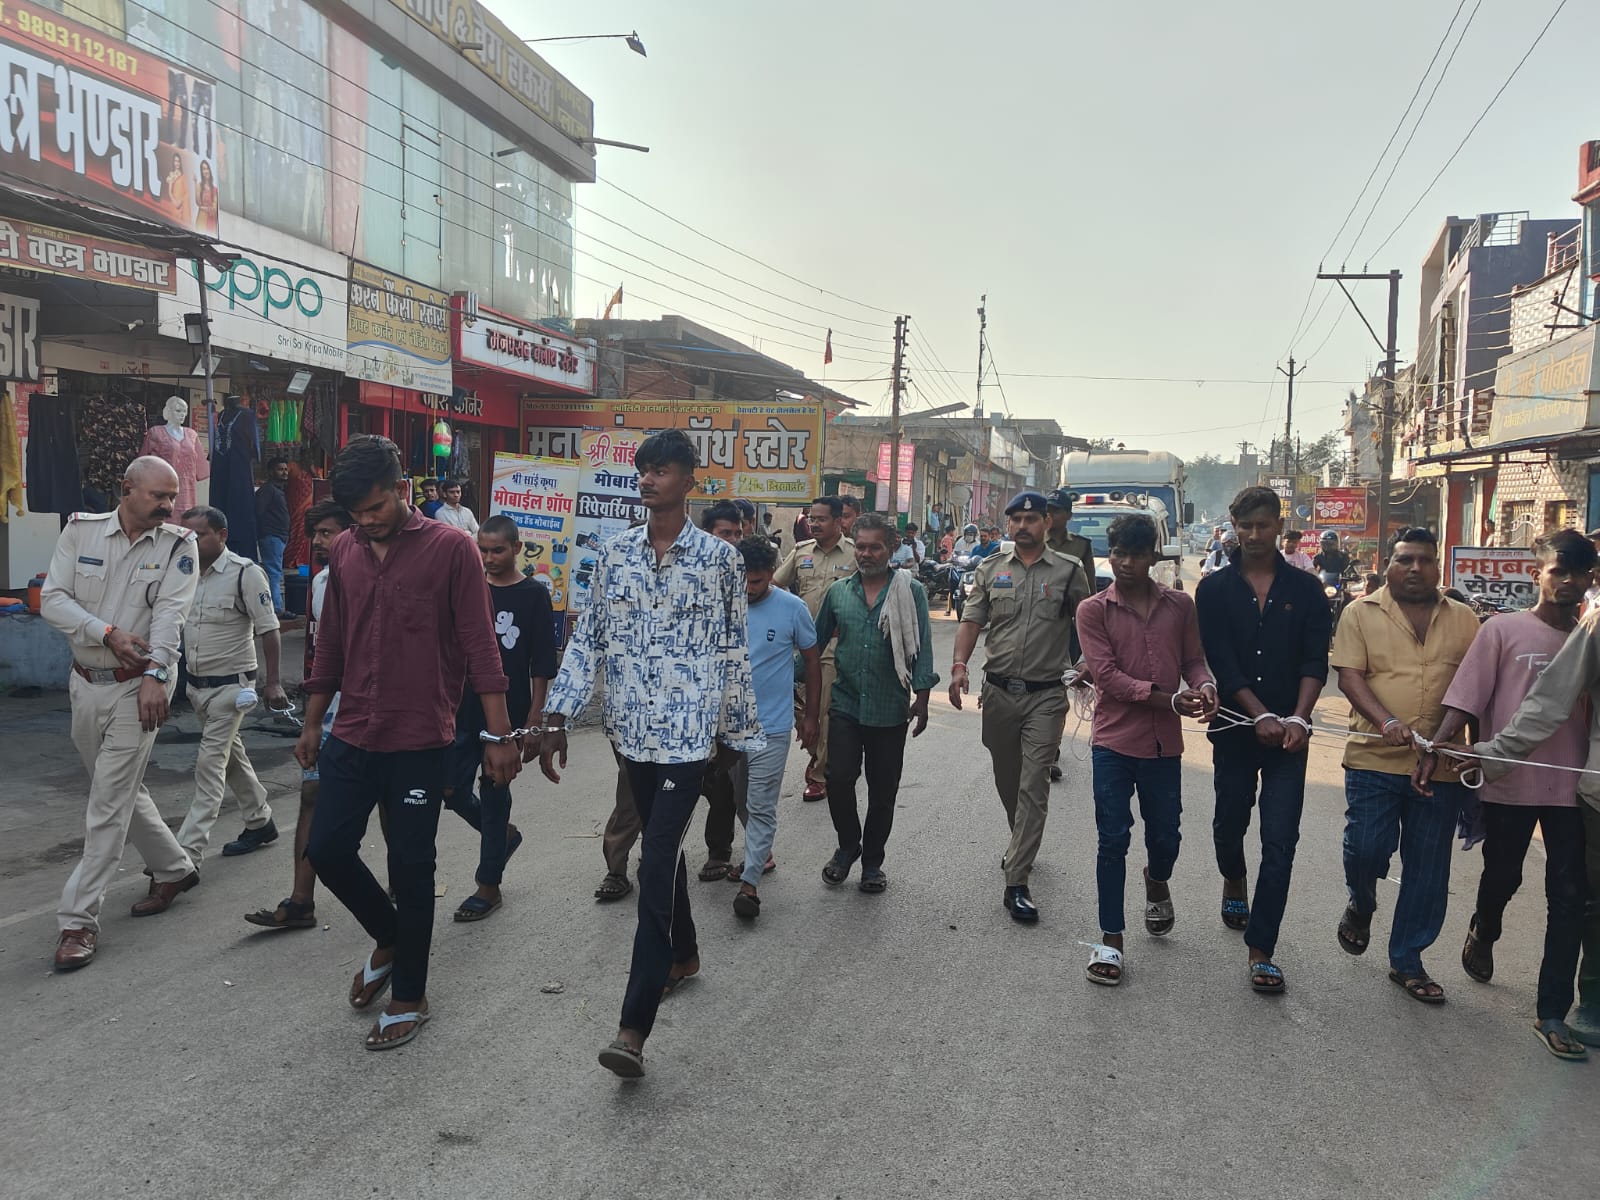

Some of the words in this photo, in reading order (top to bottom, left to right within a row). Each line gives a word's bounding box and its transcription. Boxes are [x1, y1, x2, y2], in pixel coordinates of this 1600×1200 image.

[455, 6, 469, 42] &
[17, 10, 138, 75] 9893112187
[27, 234, 87, 272] वस्त्र
[92, 248, 170, 286] भण्डार
[277, 334, 292, 347] Shri
[305, 341, 322, 355] Kripa
[584, 434, 611, 467] श्री
[743, 417, 810, 469] स्टोर
[494, 486, 544, 510] मोबाईल
[547, 493, 574, 513] शॉप
[1463, 575, 1534, 599] सेलून
